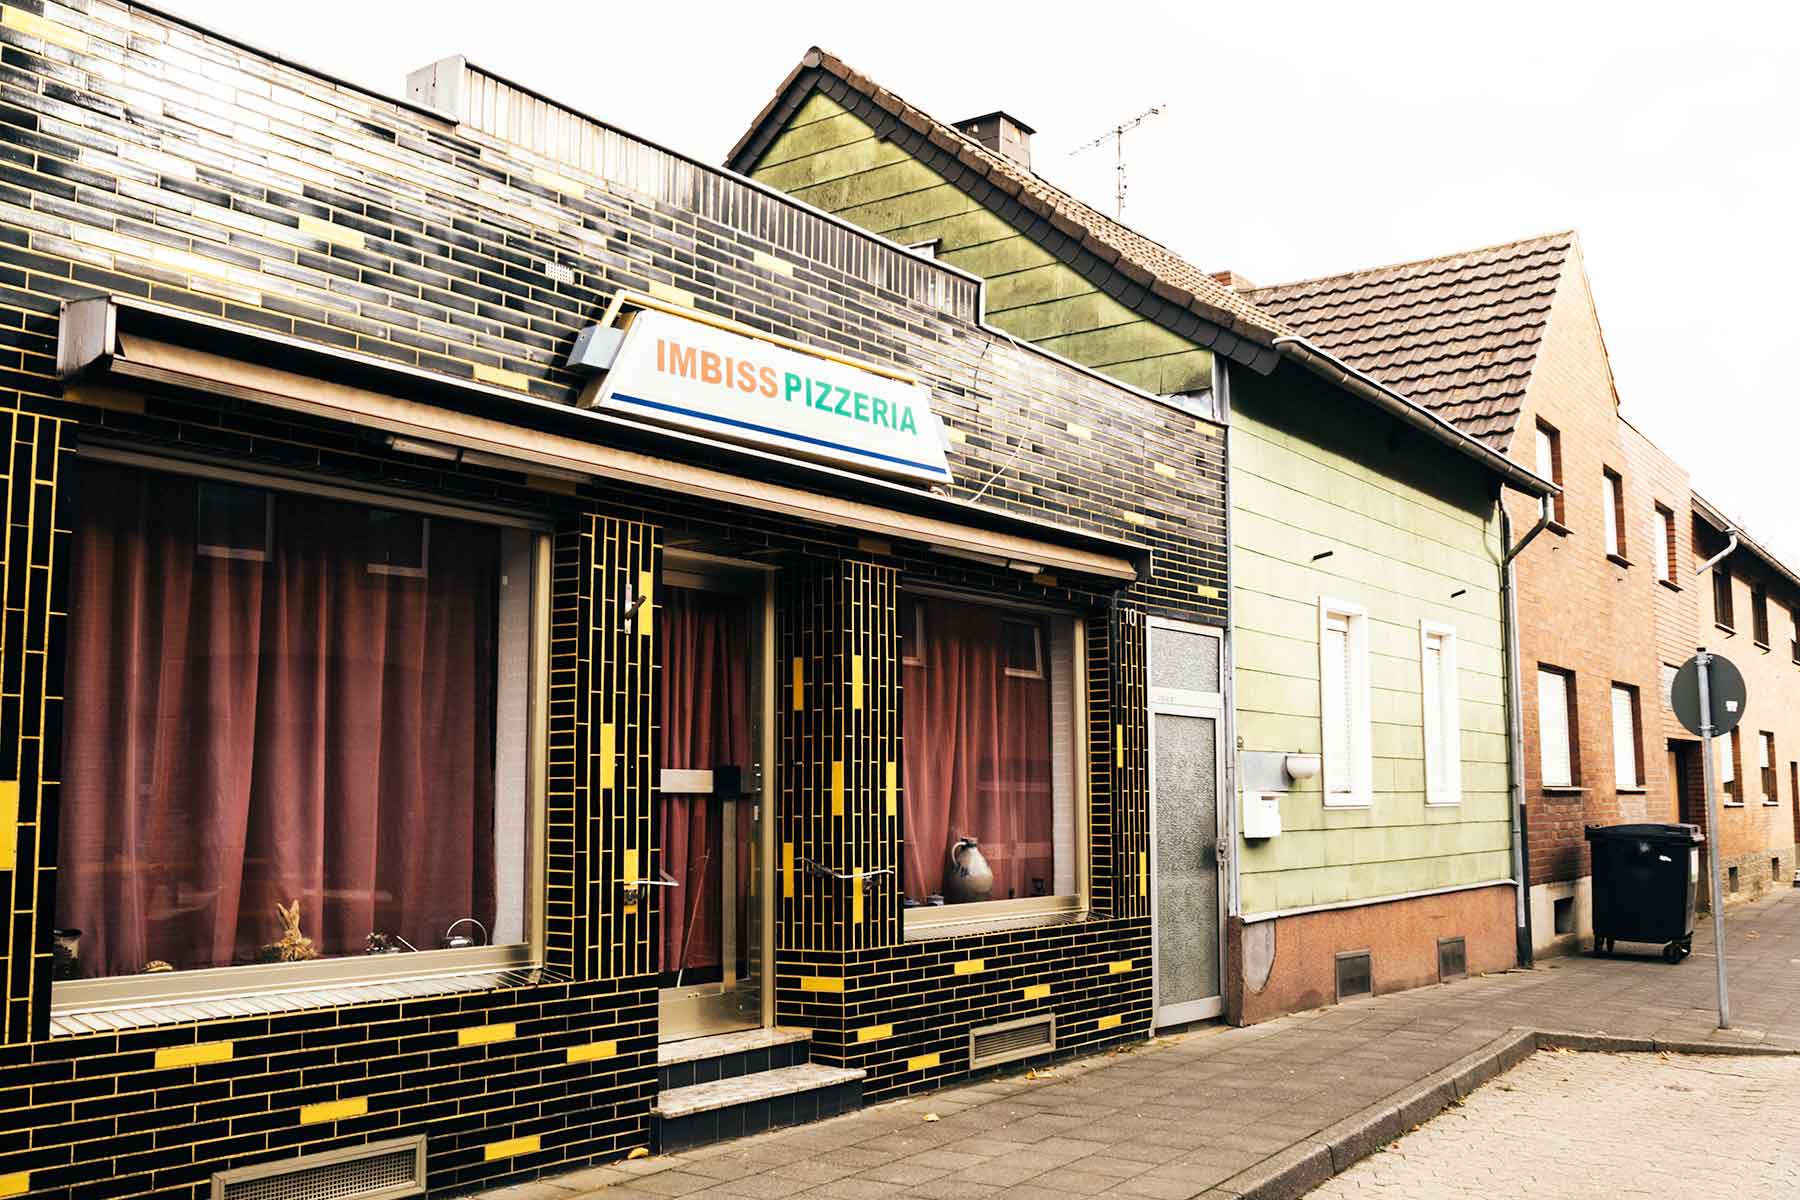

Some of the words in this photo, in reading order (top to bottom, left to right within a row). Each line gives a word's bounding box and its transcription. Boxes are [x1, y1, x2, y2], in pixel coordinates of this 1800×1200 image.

[656, 339, 779, 398] IMBISS
[784, 372, 917, 435] PIZZERIA
[1124, 607, 1137, 626] 10
